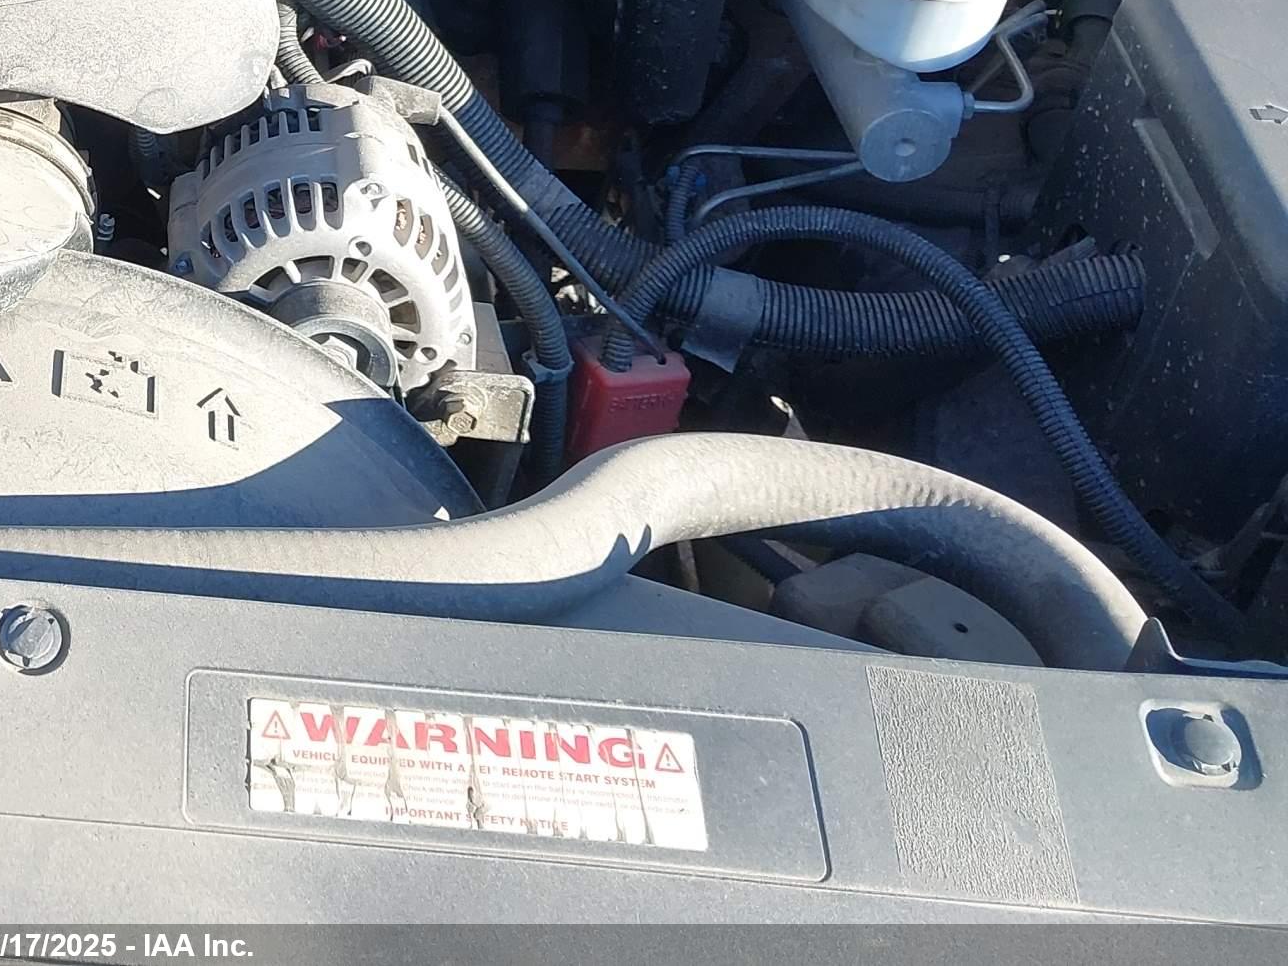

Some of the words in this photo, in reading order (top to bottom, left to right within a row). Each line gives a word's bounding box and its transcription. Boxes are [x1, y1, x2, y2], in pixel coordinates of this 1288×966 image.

[300, 711, 647, 770] WARNING
[293, 749, 343, 762] VEHICL
[351, 754, 415, 768] EQUIPED
[419, 760, 453, 771] WITH
[457, 763, 466, 773] A
[502, 767, 555, 780] REMOTE
[559, 772, 601, 784] START
[385, 807, 462, 821] IMPORTANT
[466, 813, 515, 826] SFETY
